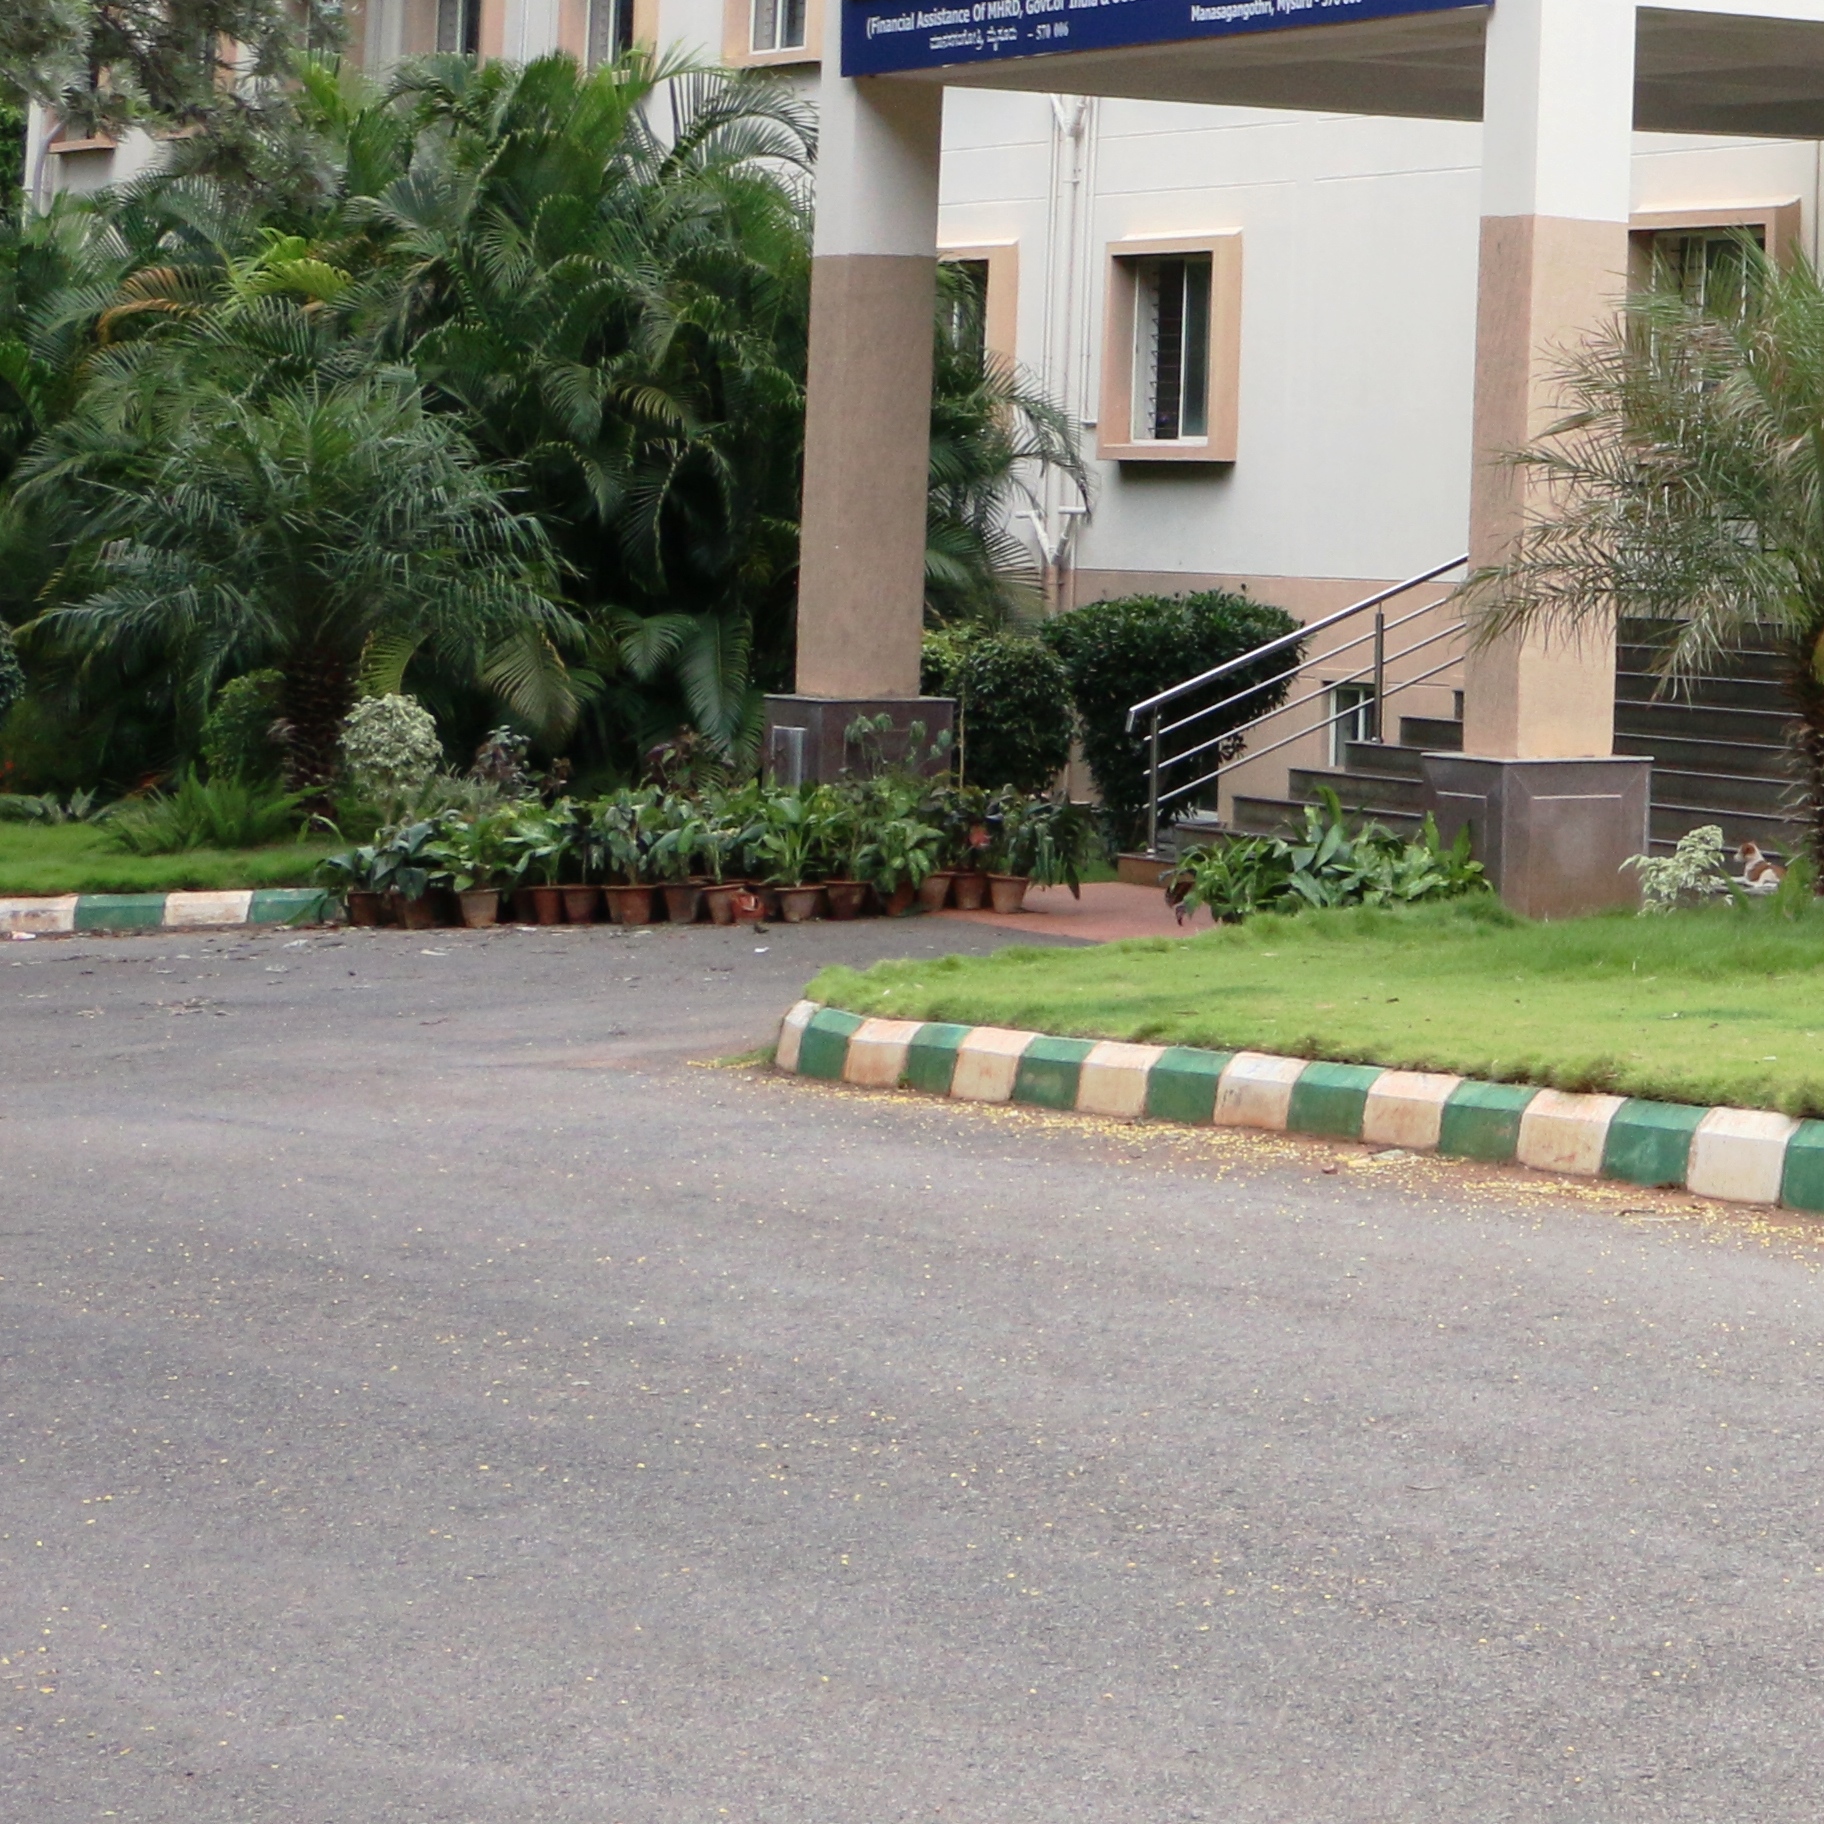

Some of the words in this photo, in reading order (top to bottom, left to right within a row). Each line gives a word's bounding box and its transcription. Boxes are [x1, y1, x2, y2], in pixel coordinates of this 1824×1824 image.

[867, 13, 914, 39] (Financial
[917, 6, 970, 28] Assistance
[987, 1, 1022, 19] MHRD,
